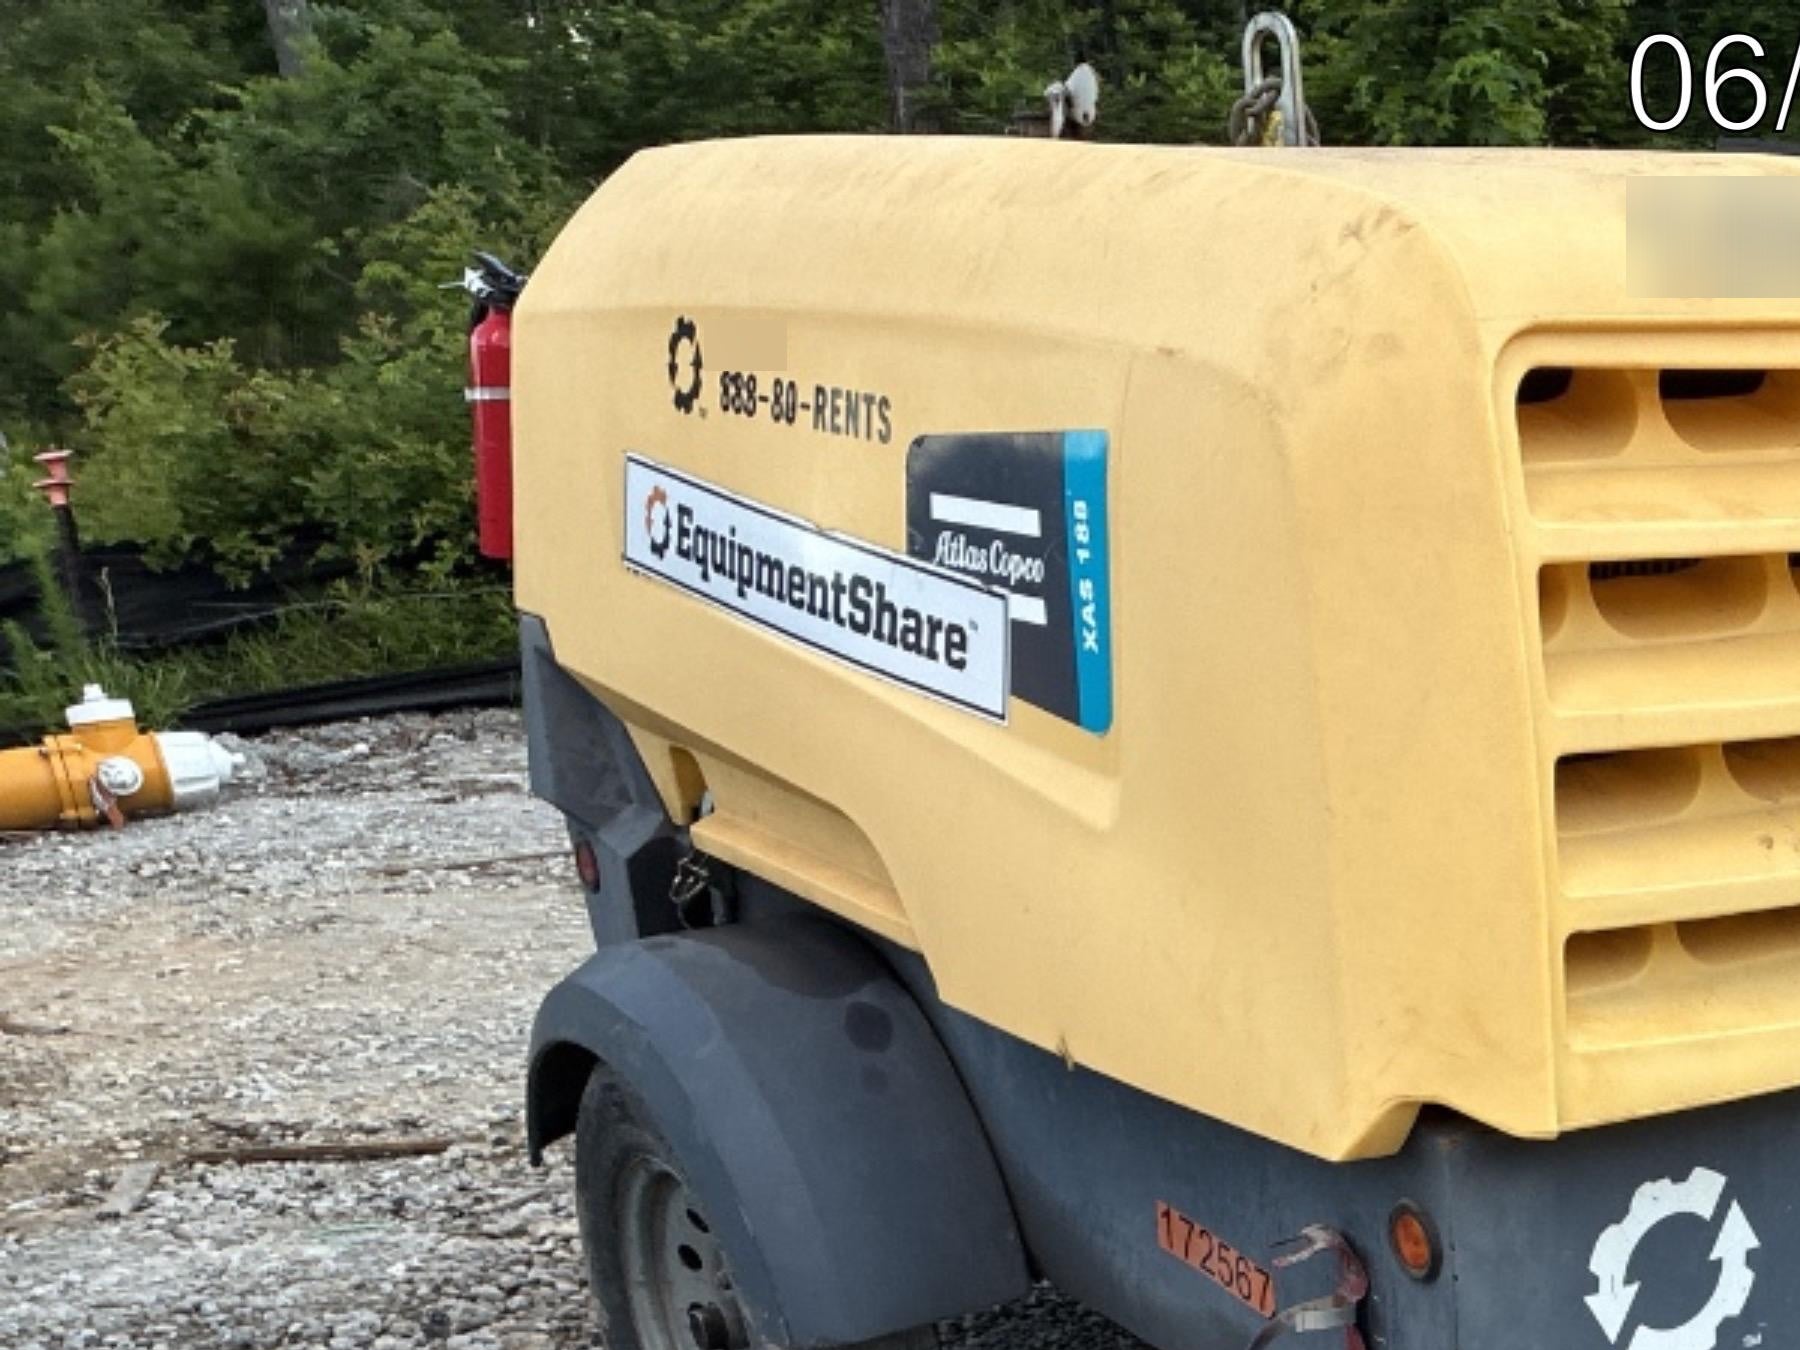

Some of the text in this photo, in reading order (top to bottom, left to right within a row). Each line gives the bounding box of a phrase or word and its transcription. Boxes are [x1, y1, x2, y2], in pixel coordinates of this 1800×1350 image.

[675, 503, 967, 670] EquipmentShare
[932, 530, 1045, 586] Atlas Copco
[1078, 578, 1099, 654] XAS
[1160, 1207, 1270, 1311] 172567
